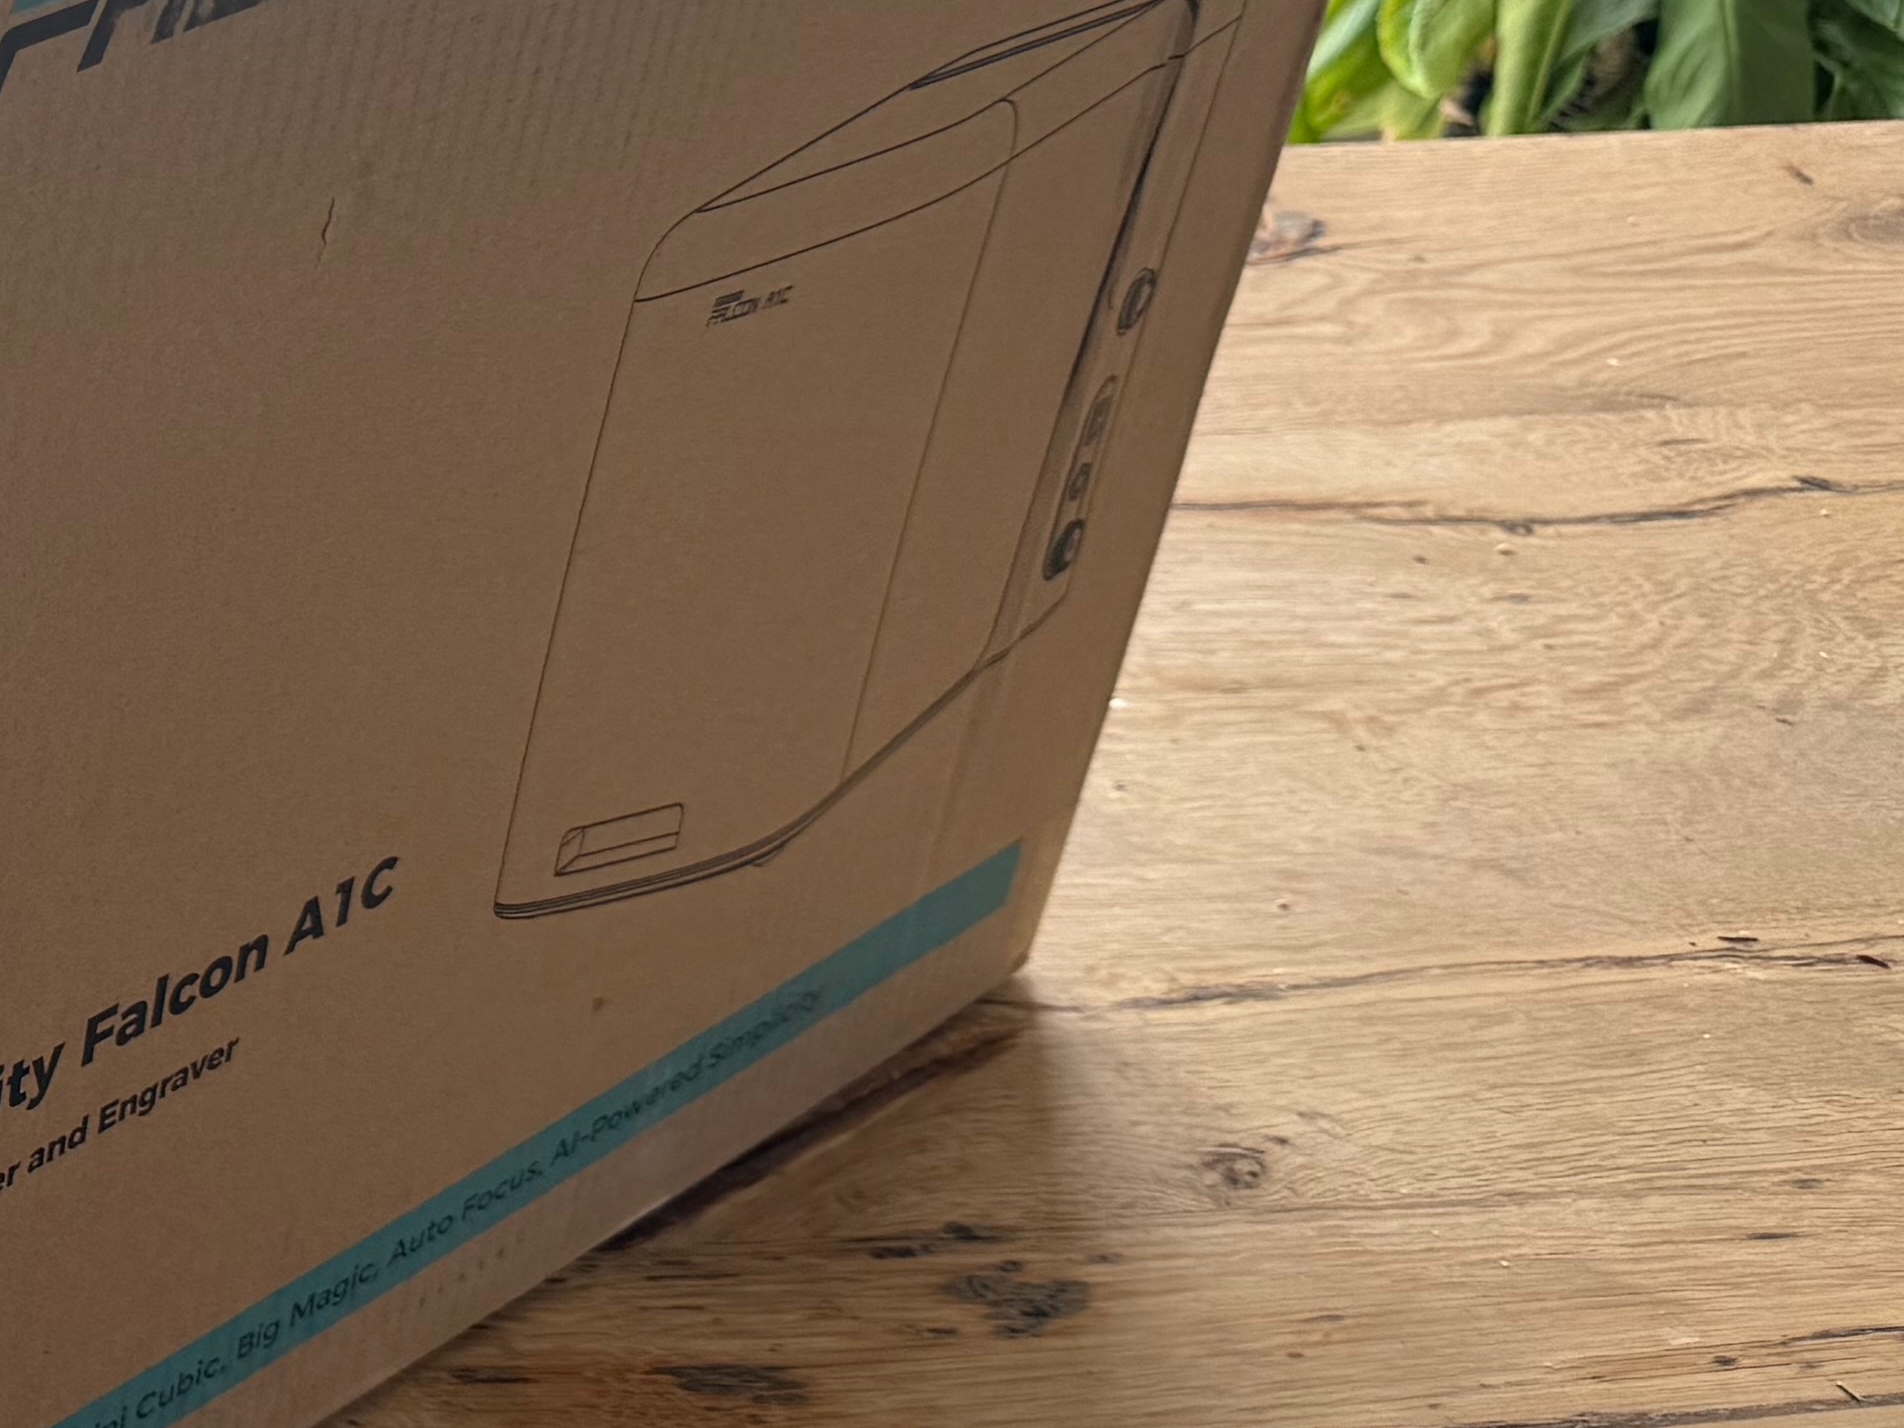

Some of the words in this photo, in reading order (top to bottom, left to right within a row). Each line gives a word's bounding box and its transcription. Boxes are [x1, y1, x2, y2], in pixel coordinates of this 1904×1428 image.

[81, 933, 268, 1067] Falcon
[283, 857, 398, 956] A1C
[27, 1116, 90, 1173] and
[97, 1038, 240, 1135] Engraver
[235, 1319, 282, 1364] Big
[387, 1213, 453, 1267] Auto
[550, 1059, 705, 1166] AI-Powered
